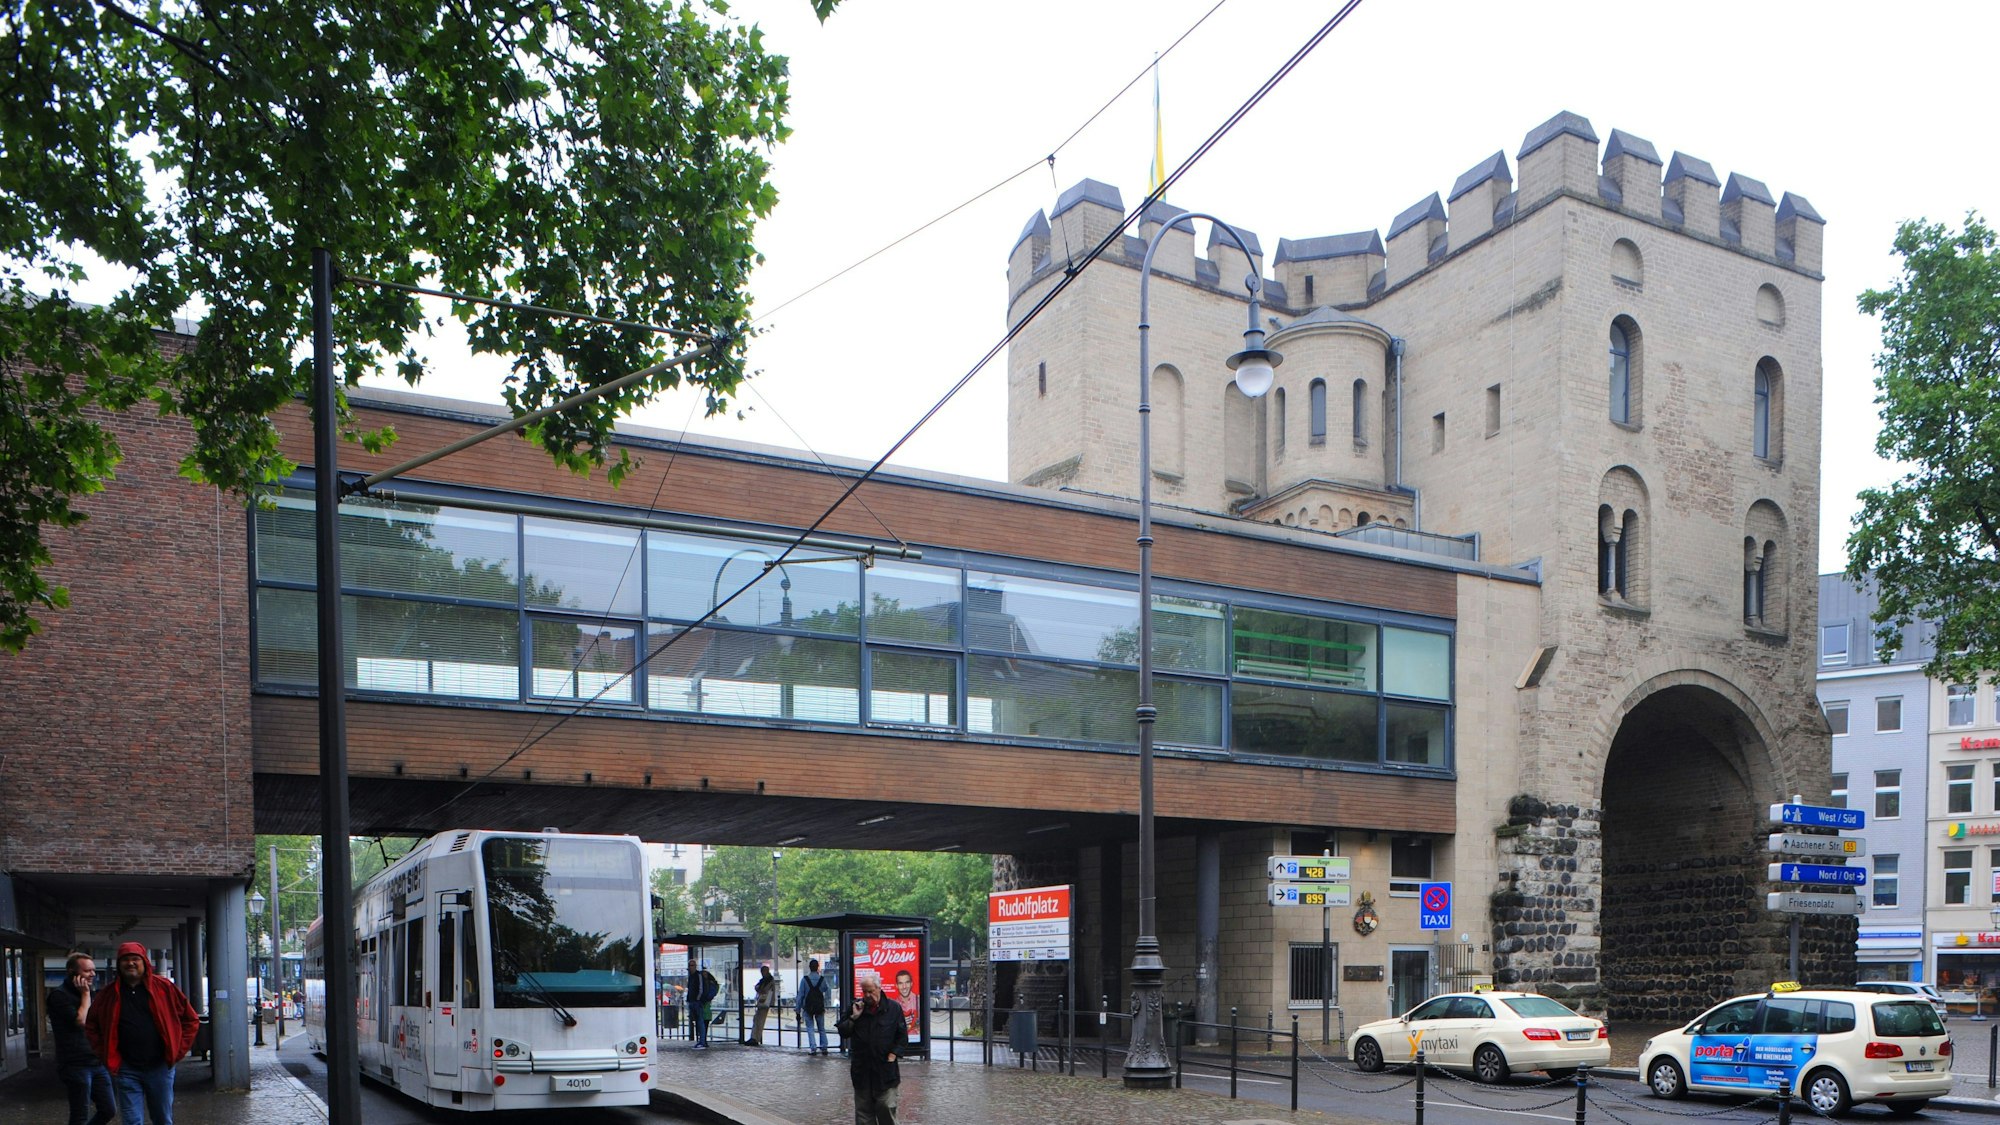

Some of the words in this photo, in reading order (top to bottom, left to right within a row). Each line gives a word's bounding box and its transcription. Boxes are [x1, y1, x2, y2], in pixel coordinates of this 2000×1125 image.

[1961, 736, 2000, 751] Kam
[1818, 811, 1836, 823] West
[1842, 813, 1857, 824] Süd
[1790, 839, 1825, 850] Aachener
[1828, 841, 1842, 851] Str.
[1847, 843, 1855, 851] 55
[1305, 867, 1324, 878] 428
[1818, 869, 1837, 880] Nord
[1843, 870, 1856, 881] Ost
[1305, 893, 1324, 904] 899
[1788, 897, 1835, 909] Friesenplatz
[998, 895, 1059, 918] Rudolfplatz
[1423, 914, 1449, 926] TAXI
[1978, 932, 2000, 943] Ka
[872, 949, 916, 966] Wiesn
[1421, 1034, 1458, 1053] mytaxi
[1695, 1044, 1734, 1058] porta
[1762, 1053, 1793, 1061] RHEINLAND
[566, 1079, 591, 1087] 4010
